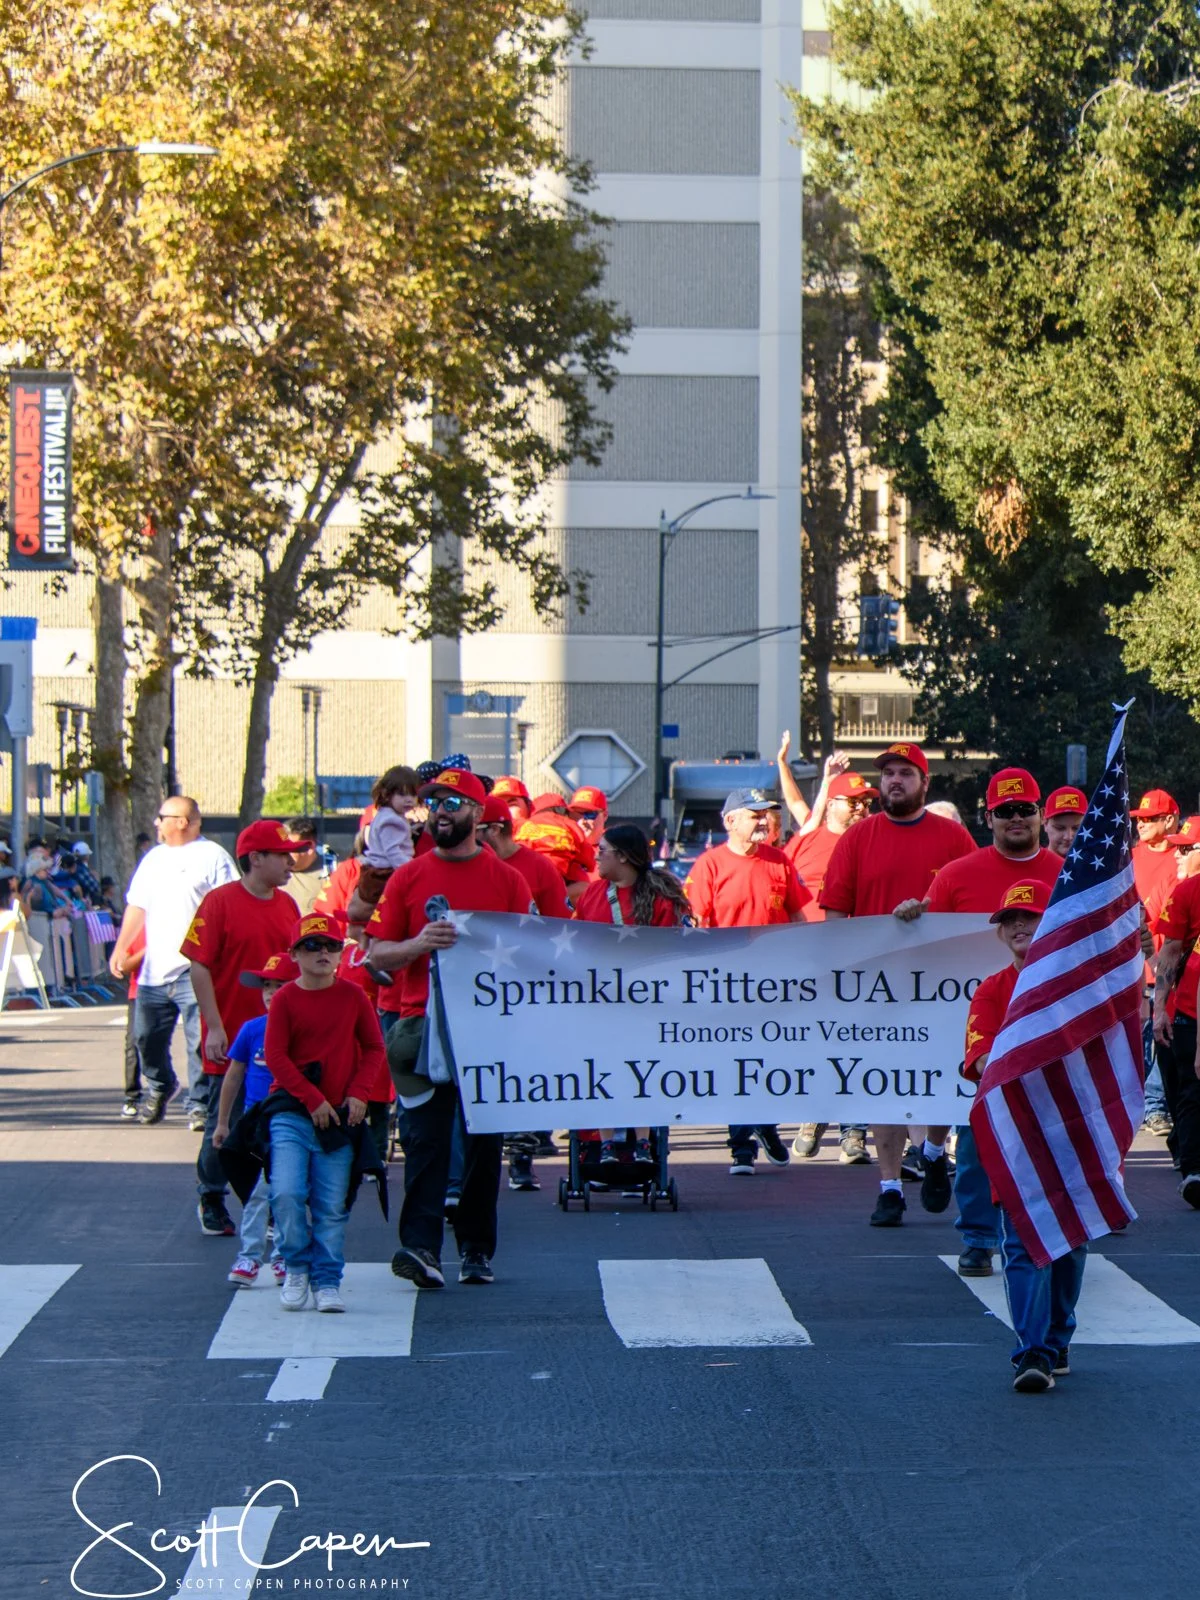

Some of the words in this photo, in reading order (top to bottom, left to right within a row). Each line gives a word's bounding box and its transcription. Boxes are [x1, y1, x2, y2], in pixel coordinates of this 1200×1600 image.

[14, 386, 42, 556] CINEQUEST
[44, 411, 67, 501] FESTIVAL
[44, 506, 66, 554] FILM
[475, 968, 668, 1015] Sprinkler
[683, 968, 817, 1004] Fitters
[832, 969, 898, 1003] UA
[660, 1021, 753, 1043] Honors
[761, 1021, 810, 1042] Our
[818, 1020, 929, 1042] Veterans
[463, 1058, 613, 1104] Thank
[625, 1059, 717, 1098] You
[735, 1058, 815, 1096] For
[828, 1056, 943, 1097] Your
